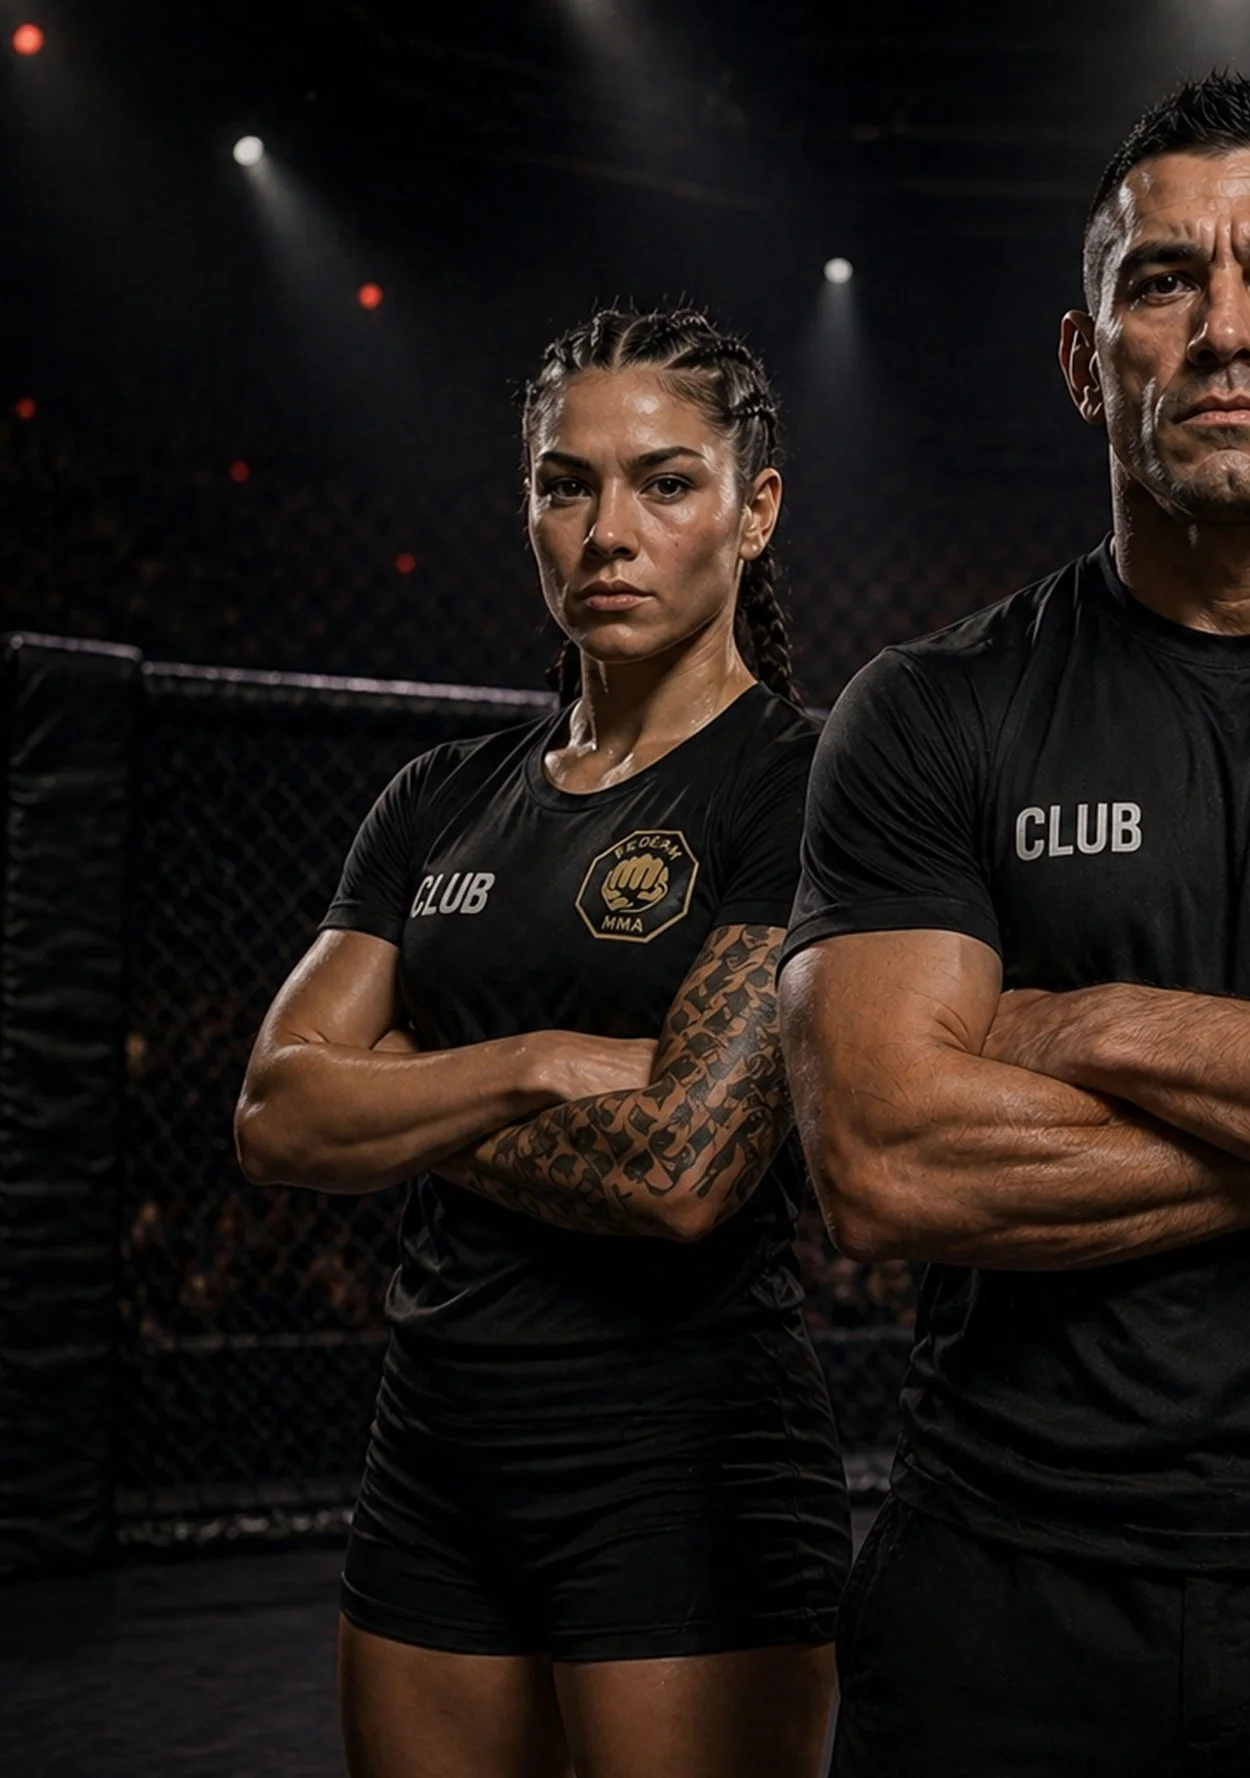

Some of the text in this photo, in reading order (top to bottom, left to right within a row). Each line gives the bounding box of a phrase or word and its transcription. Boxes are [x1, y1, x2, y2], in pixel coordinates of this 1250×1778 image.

[1015, 802, 1143, 861] CLUB
[410, 872, 495, 918] CLUB
[600, 914, 643, 932] MMA
